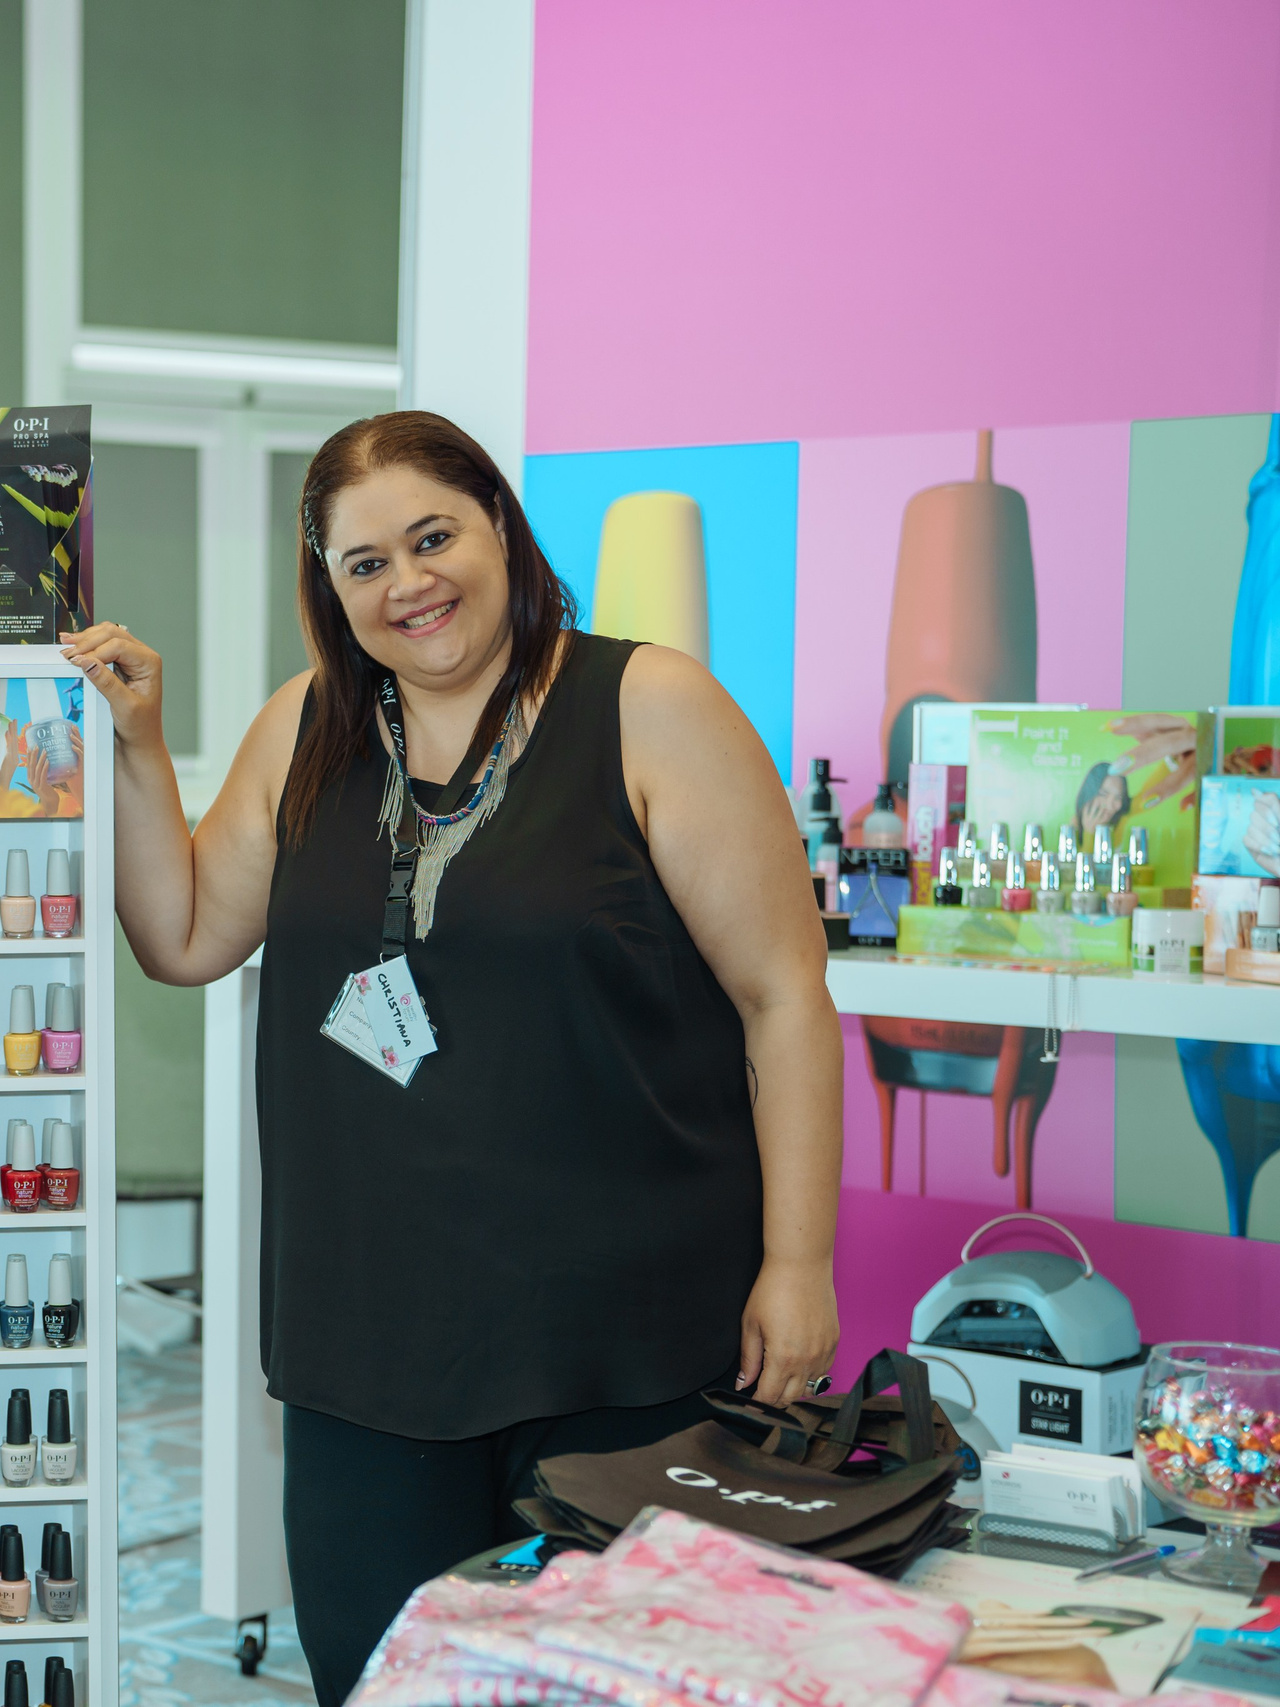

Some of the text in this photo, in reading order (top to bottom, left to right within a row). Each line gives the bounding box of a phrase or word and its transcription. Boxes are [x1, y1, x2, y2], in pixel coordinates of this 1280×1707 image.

[14, 418, 49, 432] O·P·I
[378, 973, 411, 1048] CHRISTIANA
[47, 1178, 68, 1186] O·P·I
[45, 1315, 64, 1323] O·P·I
[1031, 1389, 1070, 1409] O·P·I
[1031, 1417, 1049, 1430] STAR
